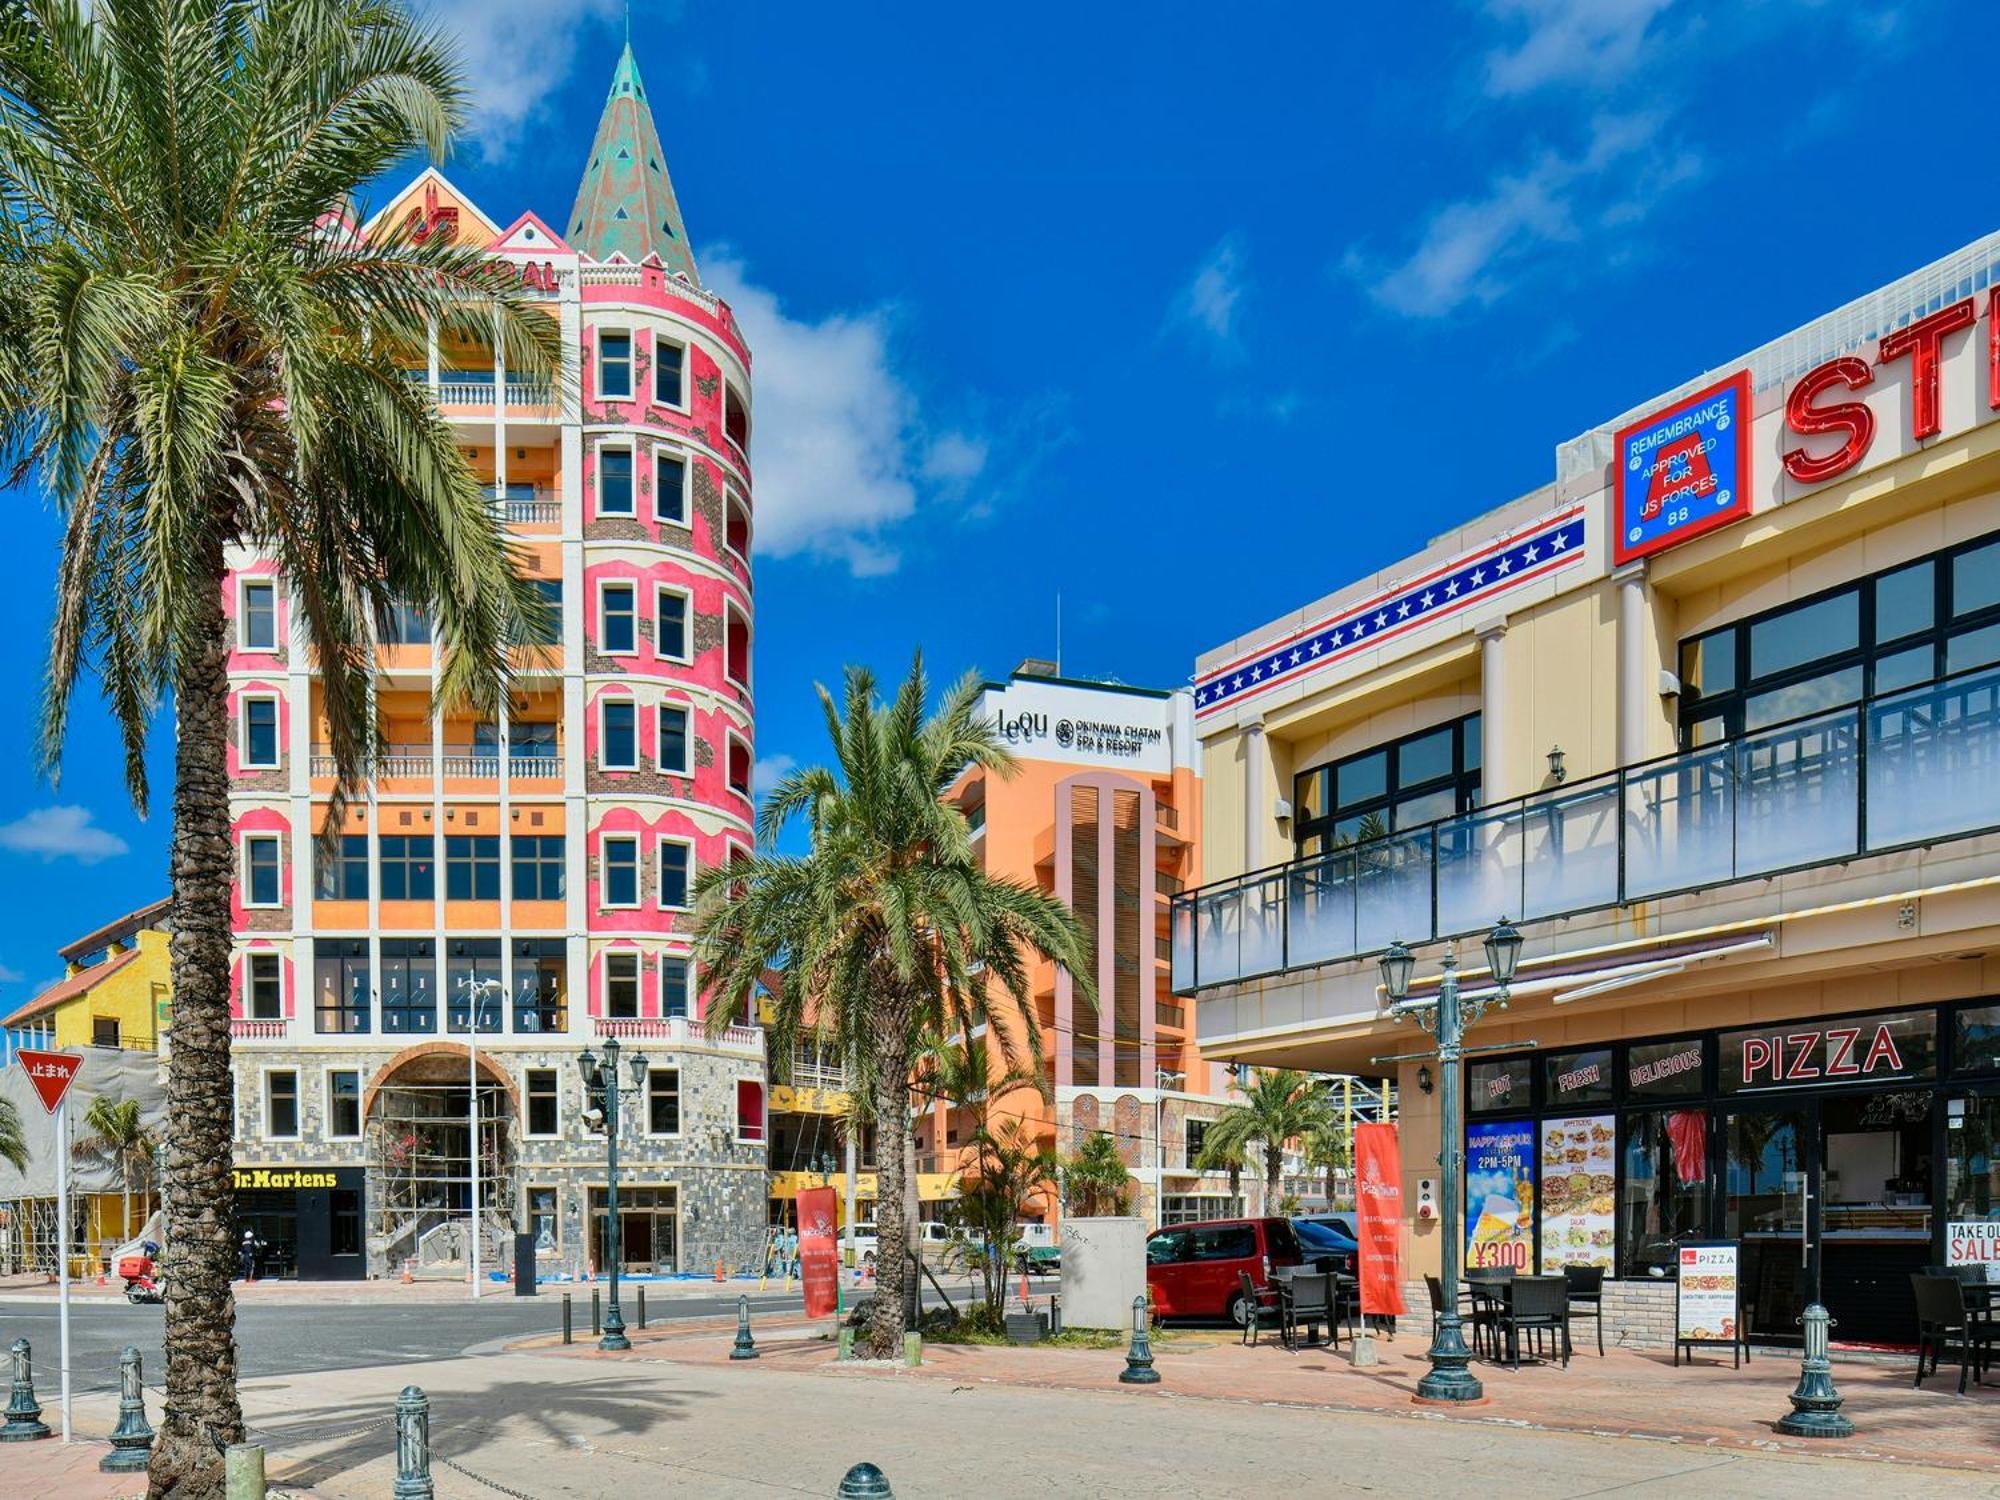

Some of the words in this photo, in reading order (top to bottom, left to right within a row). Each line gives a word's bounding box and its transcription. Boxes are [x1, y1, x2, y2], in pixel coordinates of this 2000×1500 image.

[1631, 399, 1728, 456] REMEMBRANCE
[1641, 438, 1717, 480] APPROVED
[1663, 465, 1694, 488] FOR
[1640, 498, 1658, 516] US
[1661, 473, 1718, 507] FORCES
[1668, 507, 1689, 526] 88
[1075, 720, 1121, 734] OKINAWA
[1124, 725, 1161, 739] CHATAN
[1076, 736, 1095, 746] SPA
[1098, 738, 1104, 747] &
[1106, 739, 1143, 752] RESORT
[1743, 1024, 1903, 1083] PIZZA
[31, 1062, 70, 1079] 止まれ
[1558, 1064, 1601, 1092] FRESH
[1629, 1049, 1702, 1087] DELICIOUS
[1487, 1074, 1512, 1098] HOT
[1468, 1136, 1501, 1148] HAPPY
[1503, 1133, 1532, 1146] HOUR
[1478, 1155, 1522, 1169] 2PM-5PM
[1951, 1225, 1983, 1239] TAKE
[1474, 1242, 1526, 1270] ¥300
[1699, 1255, 1735, 1264] PIZZA
[1951, 1239, 2000, 1261] SALE
